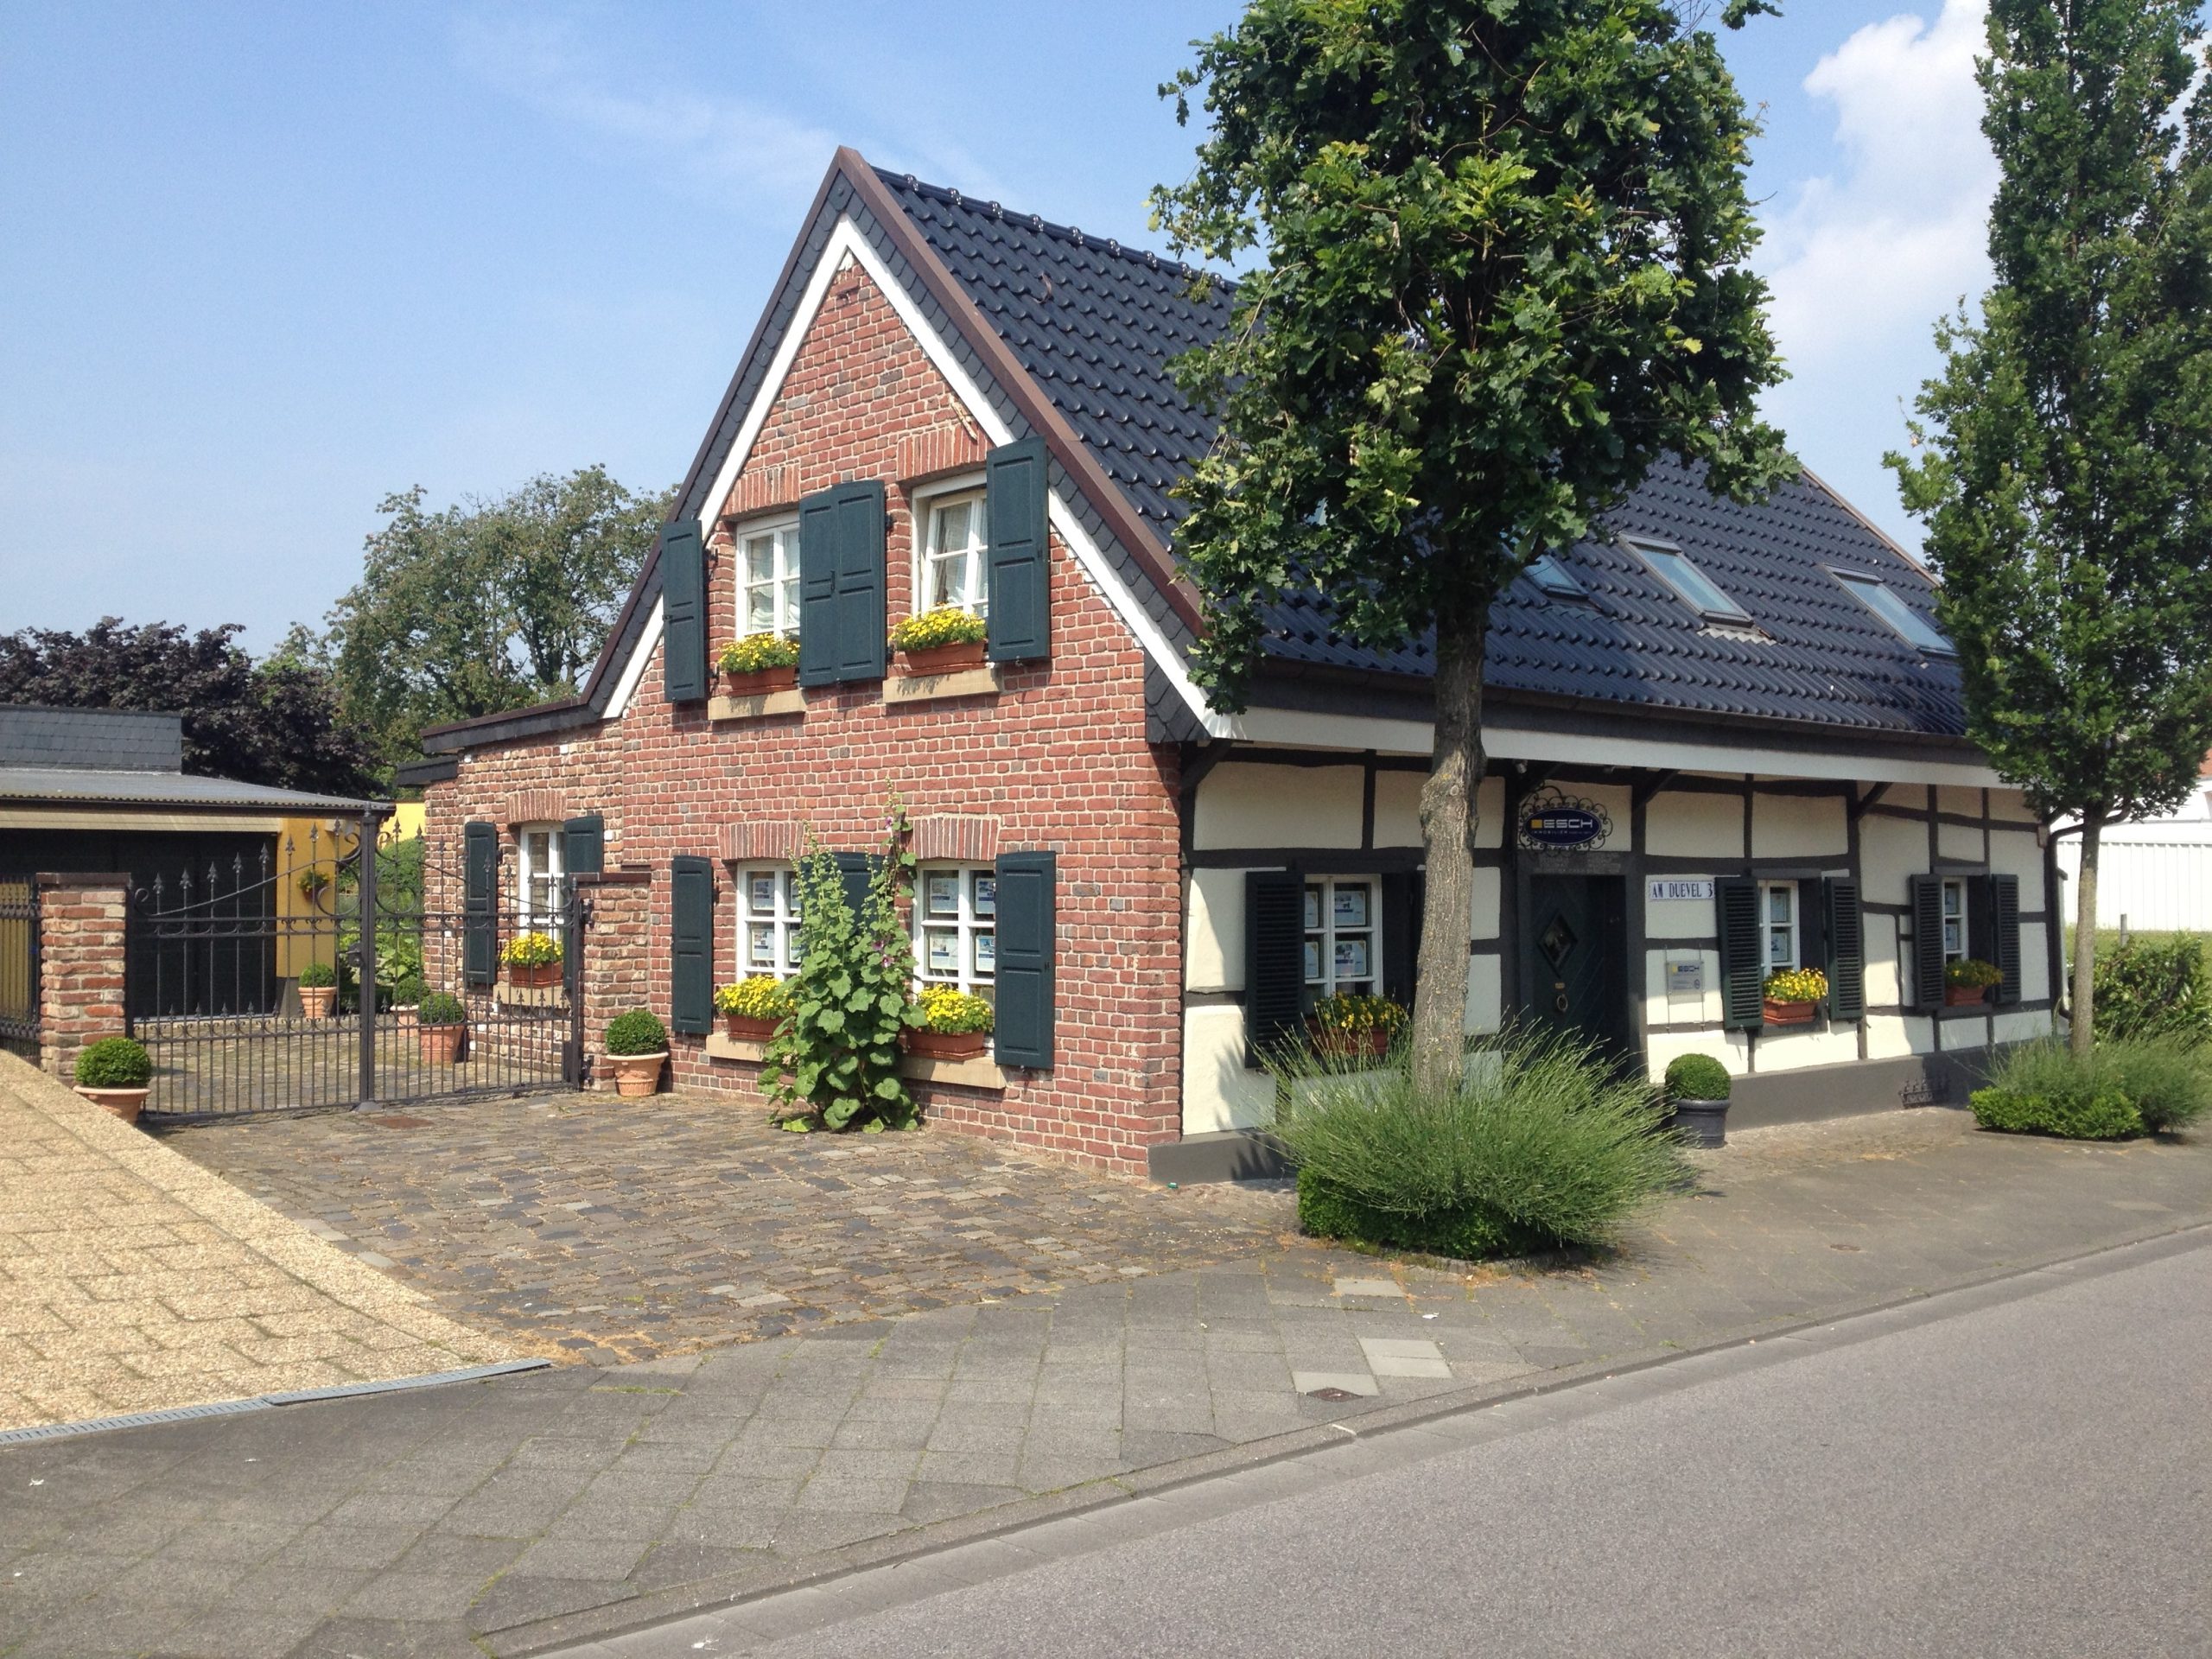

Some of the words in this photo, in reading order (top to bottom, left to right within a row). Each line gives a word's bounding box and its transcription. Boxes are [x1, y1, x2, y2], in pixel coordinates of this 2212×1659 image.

[1543, 819, 1592, 829] ESCH
[1652, 883, 1663, 898] AM
[1669, 883, 1701, 898] DUEVEL
[1707, 883, 1713, 898] 3
